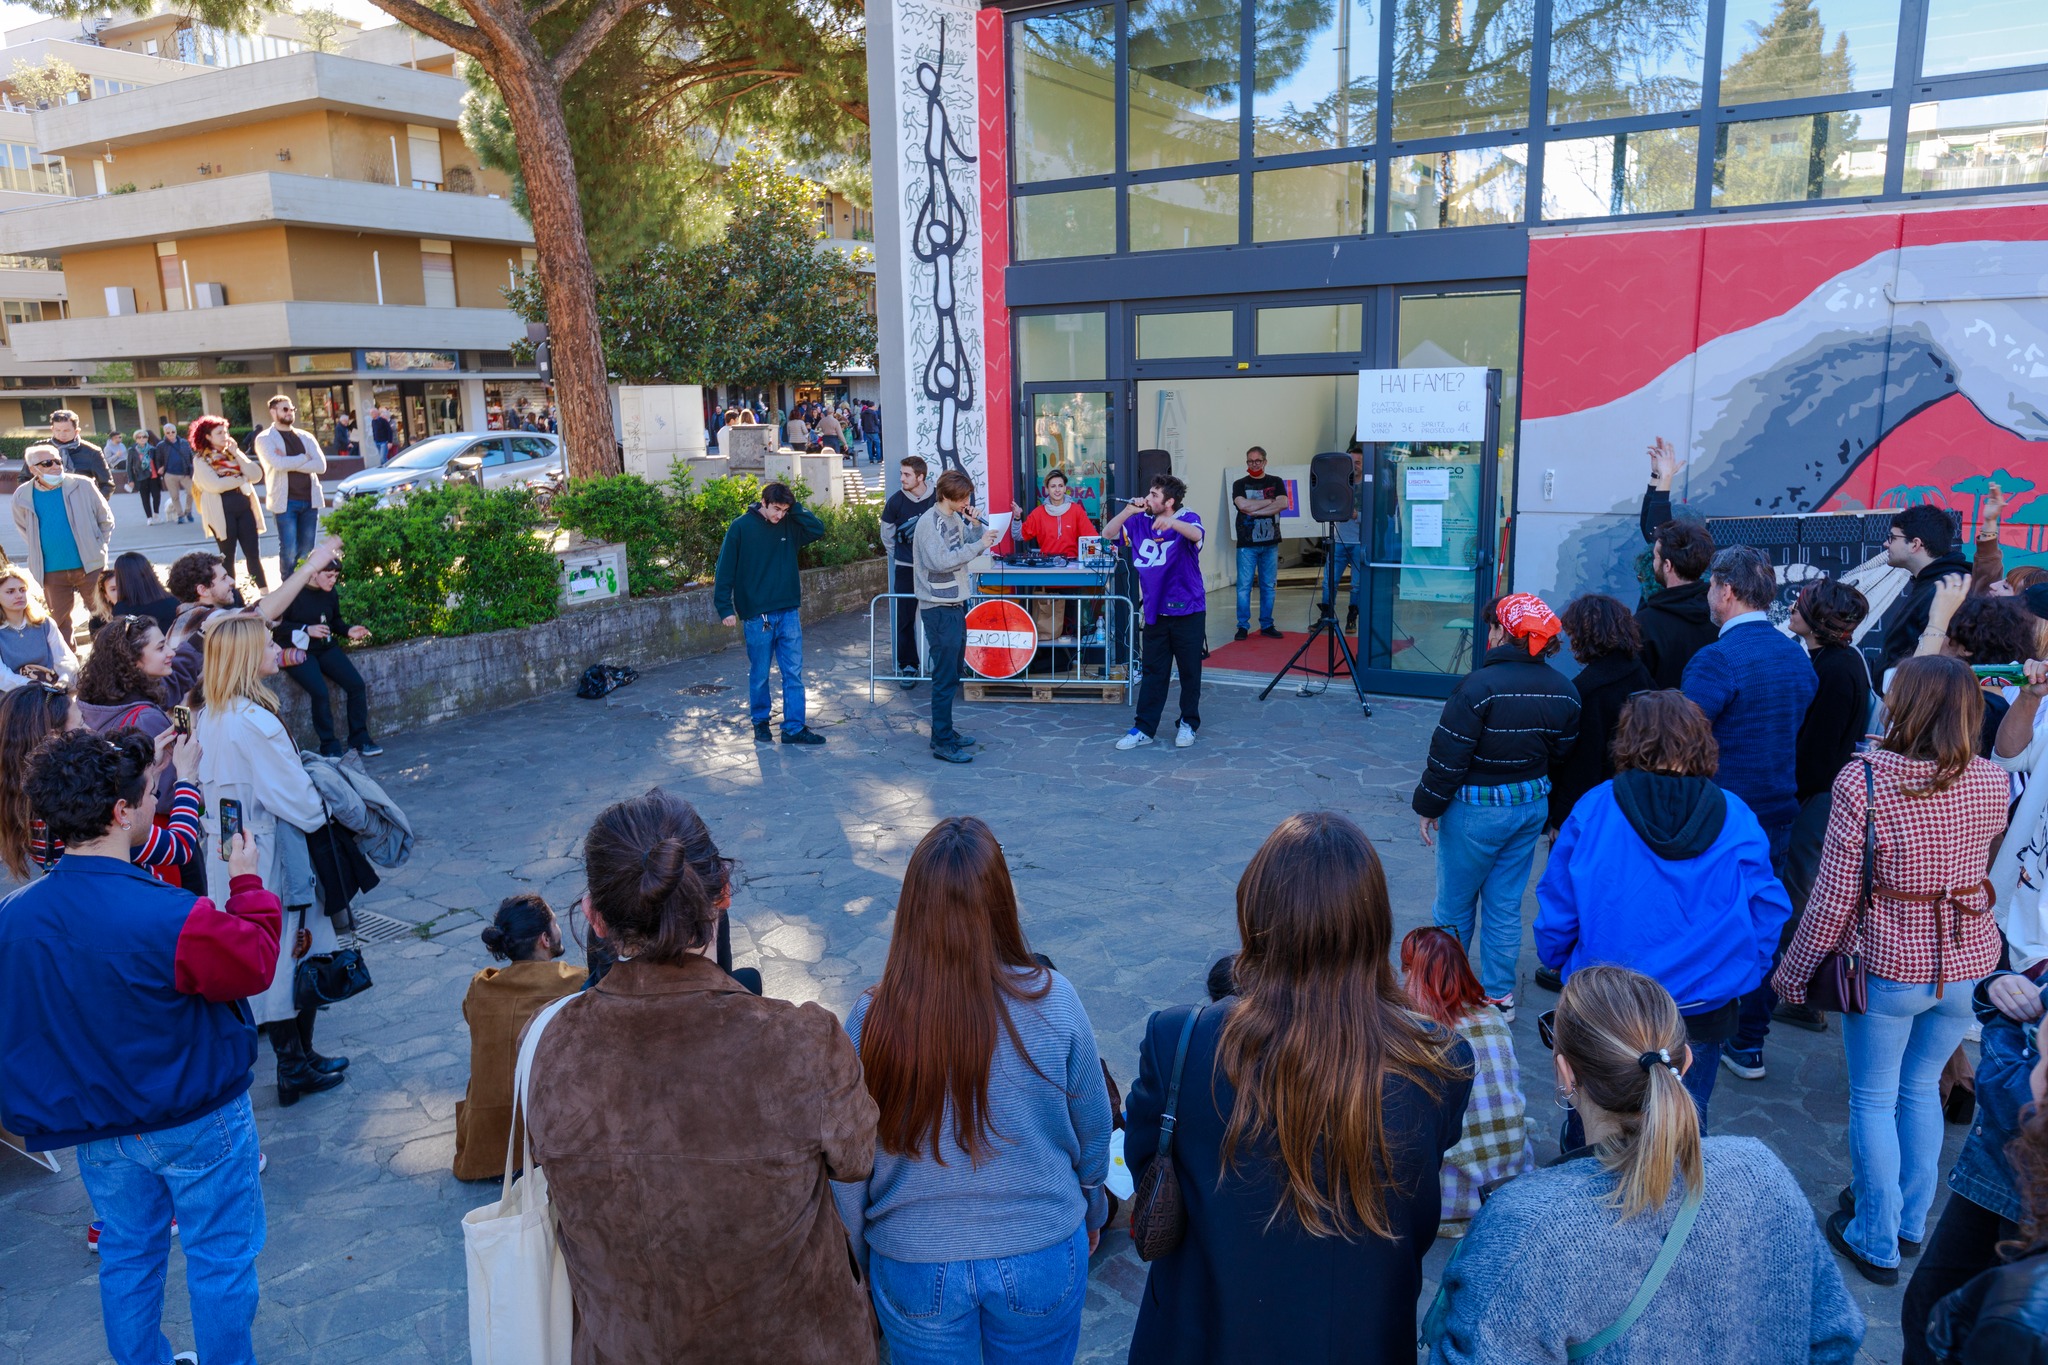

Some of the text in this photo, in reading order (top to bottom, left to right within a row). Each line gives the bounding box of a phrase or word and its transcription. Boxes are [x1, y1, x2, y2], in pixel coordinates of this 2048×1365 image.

[1380, 372, 1465, 393] HAI FAME?
[1371, 406, 1425, 414] COMPONIBILE
[1458, 400, 1472, 413] 6€
[1401, 422, 1415, 433] 3€
[1457, 422, 1472, 433] 4€
